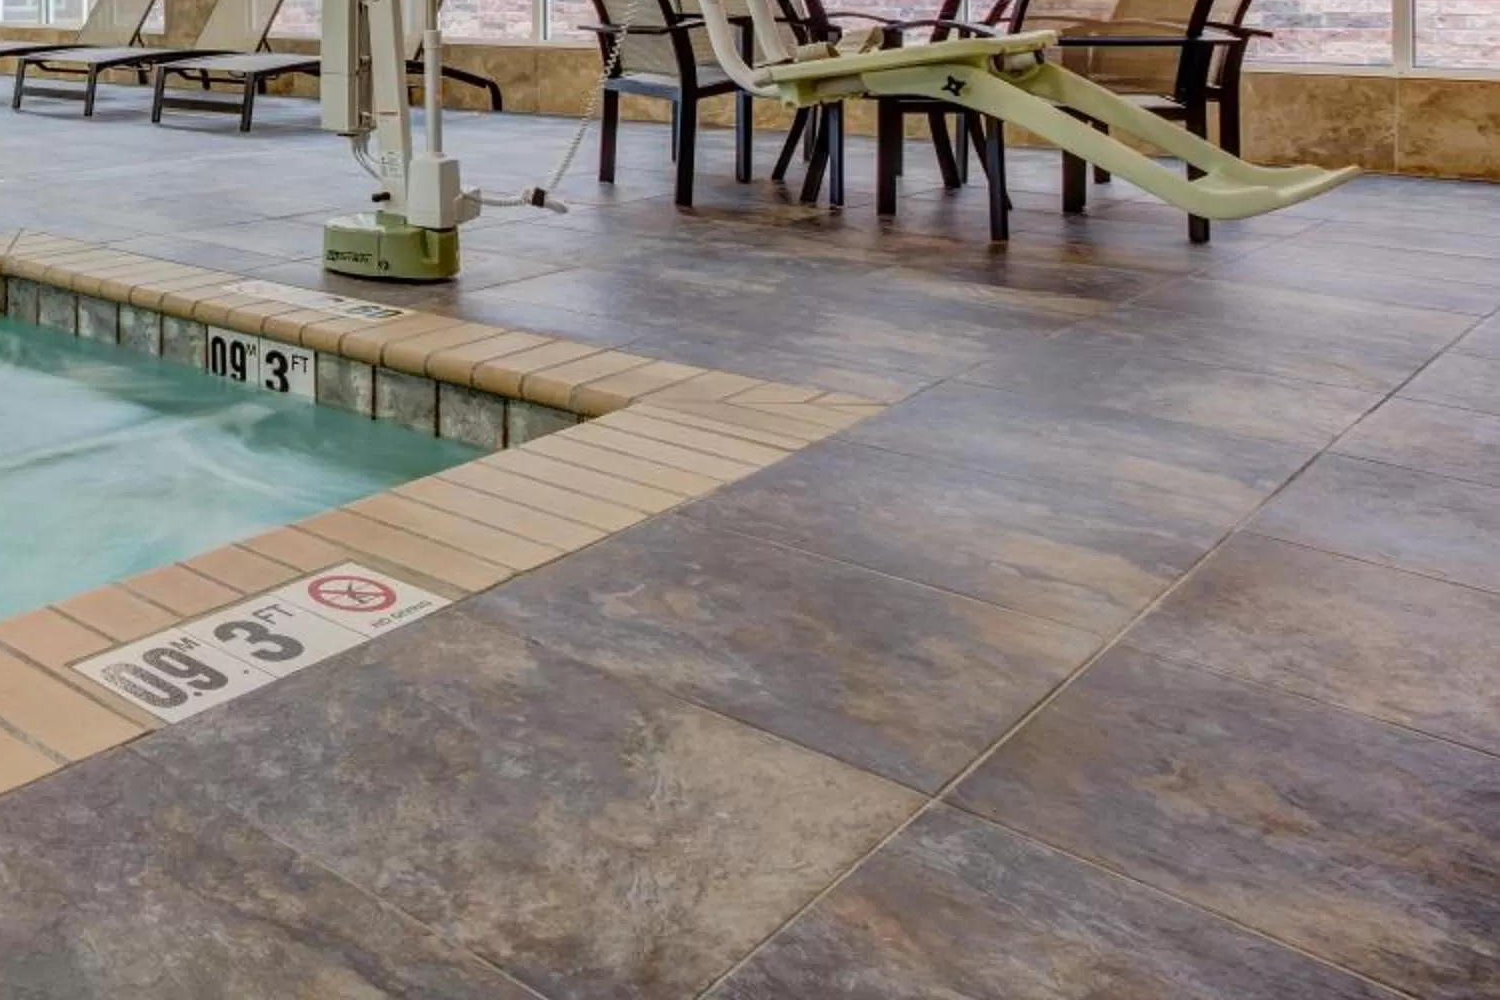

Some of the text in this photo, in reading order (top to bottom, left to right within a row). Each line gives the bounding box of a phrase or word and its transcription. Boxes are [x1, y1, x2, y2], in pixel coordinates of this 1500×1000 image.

[265, 350, 289, 393] 3
[291, 354, 309, 375] FT
[252, 603, 294, 626] FT
[213, 620, 305, 662] 3
